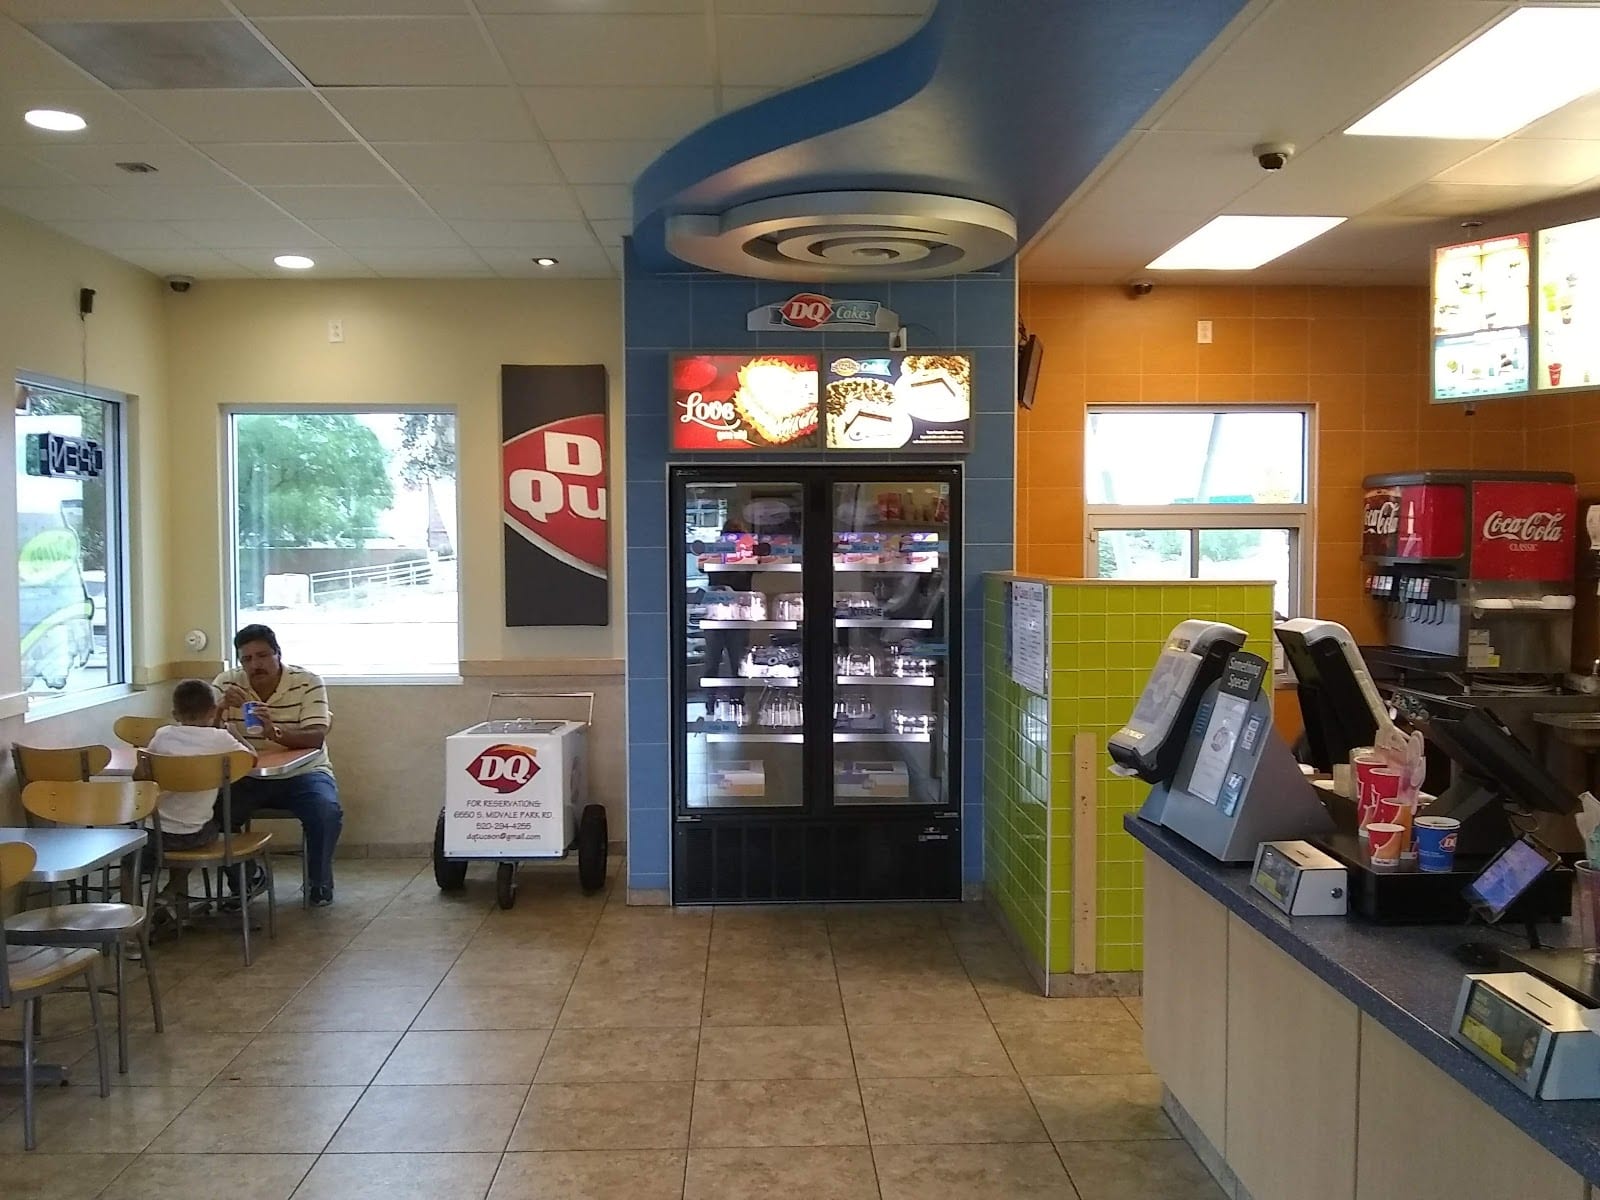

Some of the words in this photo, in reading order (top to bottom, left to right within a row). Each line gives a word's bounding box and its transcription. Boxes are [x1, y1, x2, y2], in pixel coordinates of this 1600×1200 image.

[789, 301, 827, 323] DQ
[836, 305, 872, 321] Cakes
[1228, 656, 1262, 679] Something
[1227, 673, 1252, 691] Special
[477, 754, 532, 785] DQ
[466, 799, 482, 808] FOR
[519, 811, 540, 819] PARK
